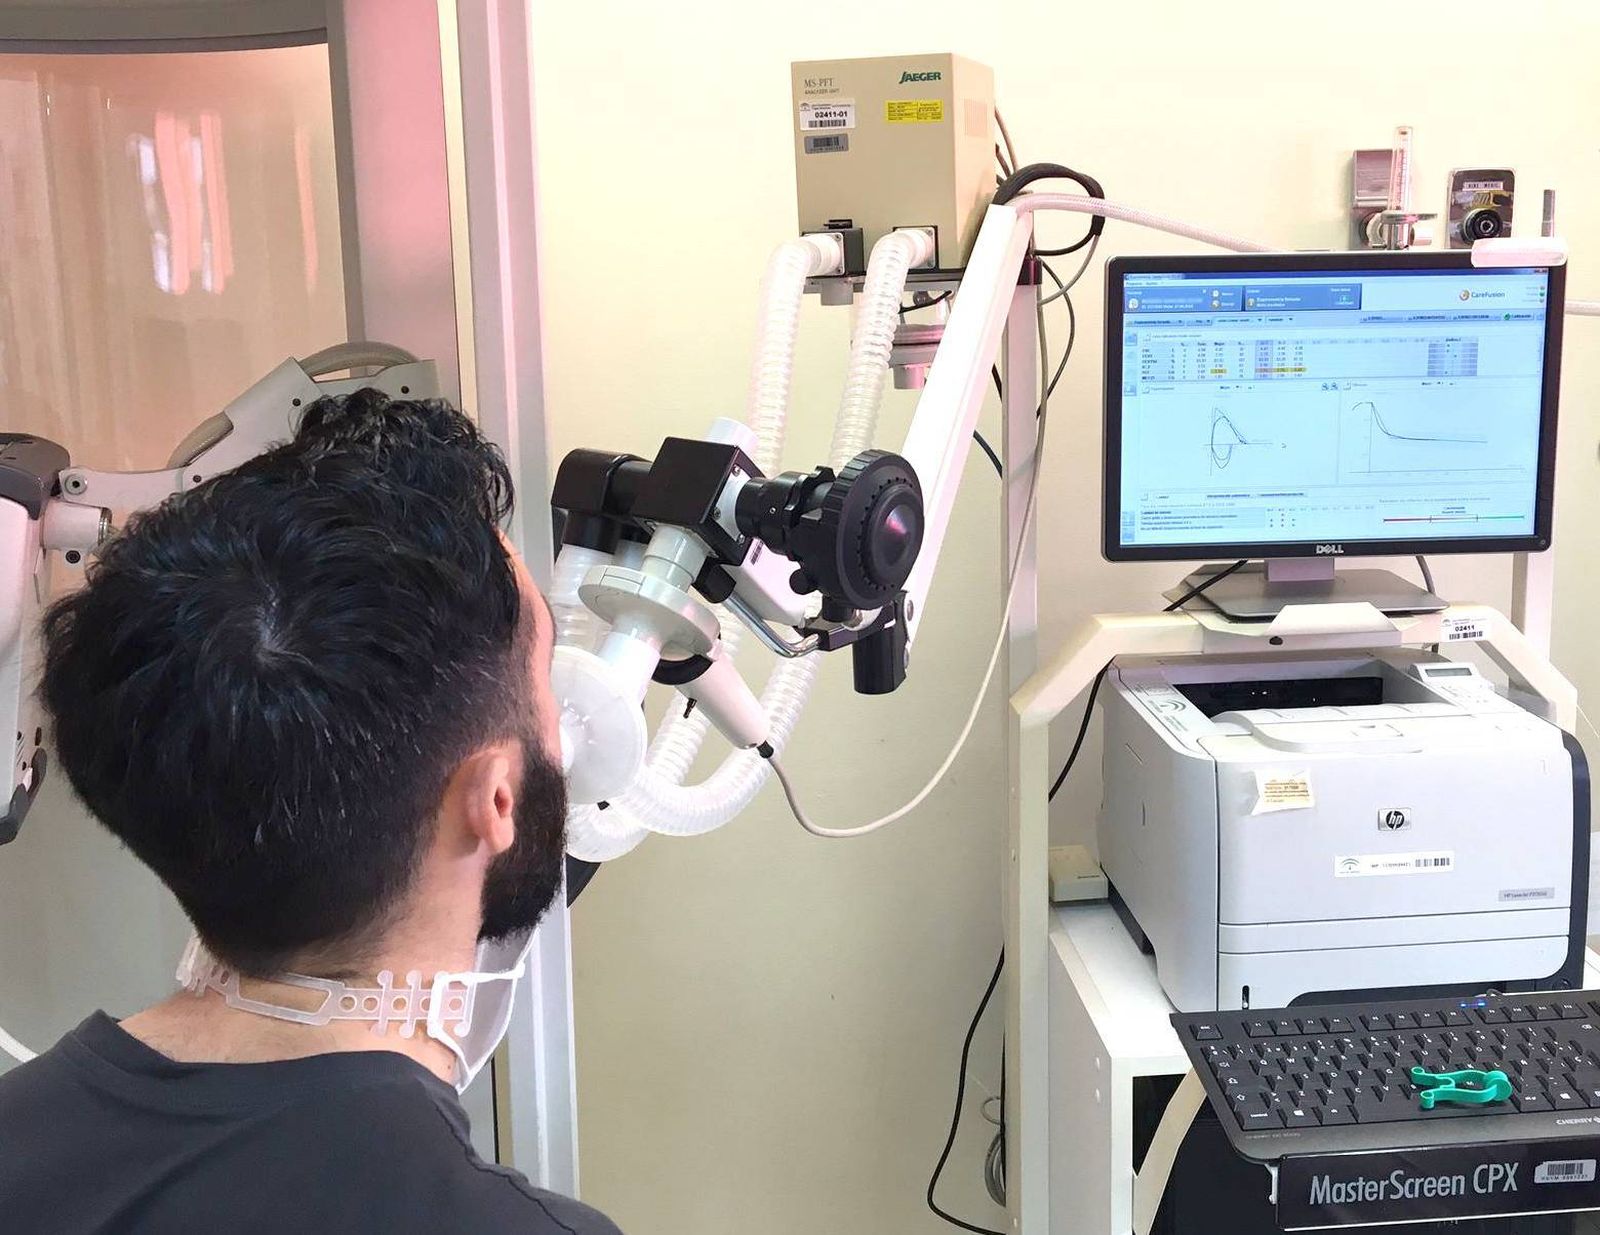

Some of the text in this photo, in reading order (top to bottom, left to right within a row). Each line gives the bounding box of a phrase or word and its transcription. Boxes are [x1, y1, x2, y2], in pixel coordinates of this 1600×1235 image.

[899, 71, 942, 84] JAEGER
[814, 109, 848, 118] 02411-01
[1471, 290, 1506, 299] CareFusion
[1315, 543, 1345, 555] DELL
[1454, 624, 1476, 632] 02411
[1388, 810, 1403, 831] hp
[1310, 1163, 1519, 1205] MasterScreen CPX
